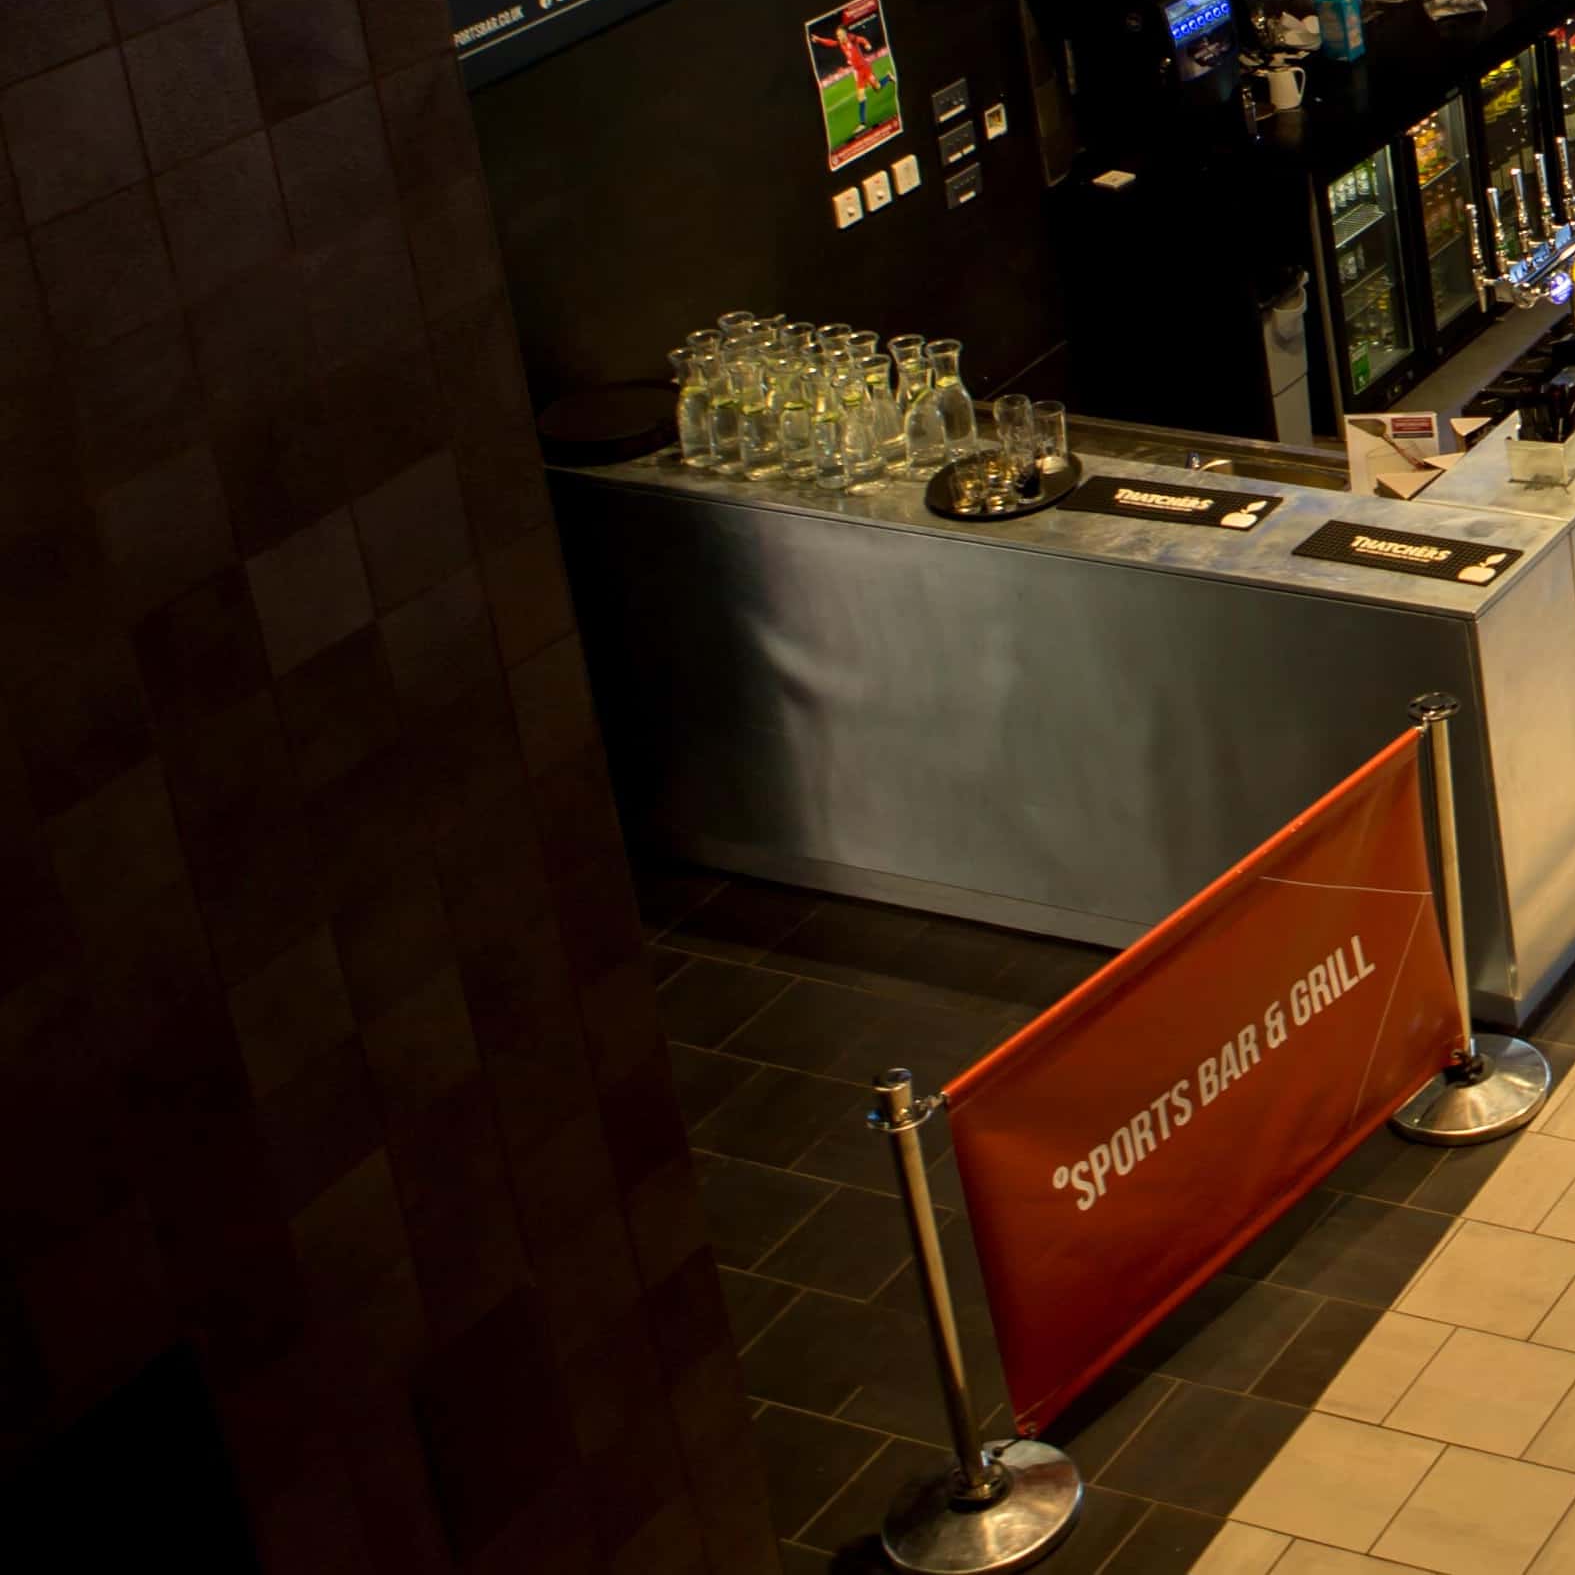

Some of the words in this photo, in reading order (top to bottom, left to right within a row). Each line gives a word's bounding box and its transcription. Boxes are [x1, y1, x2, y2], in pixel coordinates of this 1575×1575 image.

[1198, 1023, 1263, 1108] BAR
[1263, 1000, 1288, 1050] &
[1289, 934, 1376, 1027] GRILL
